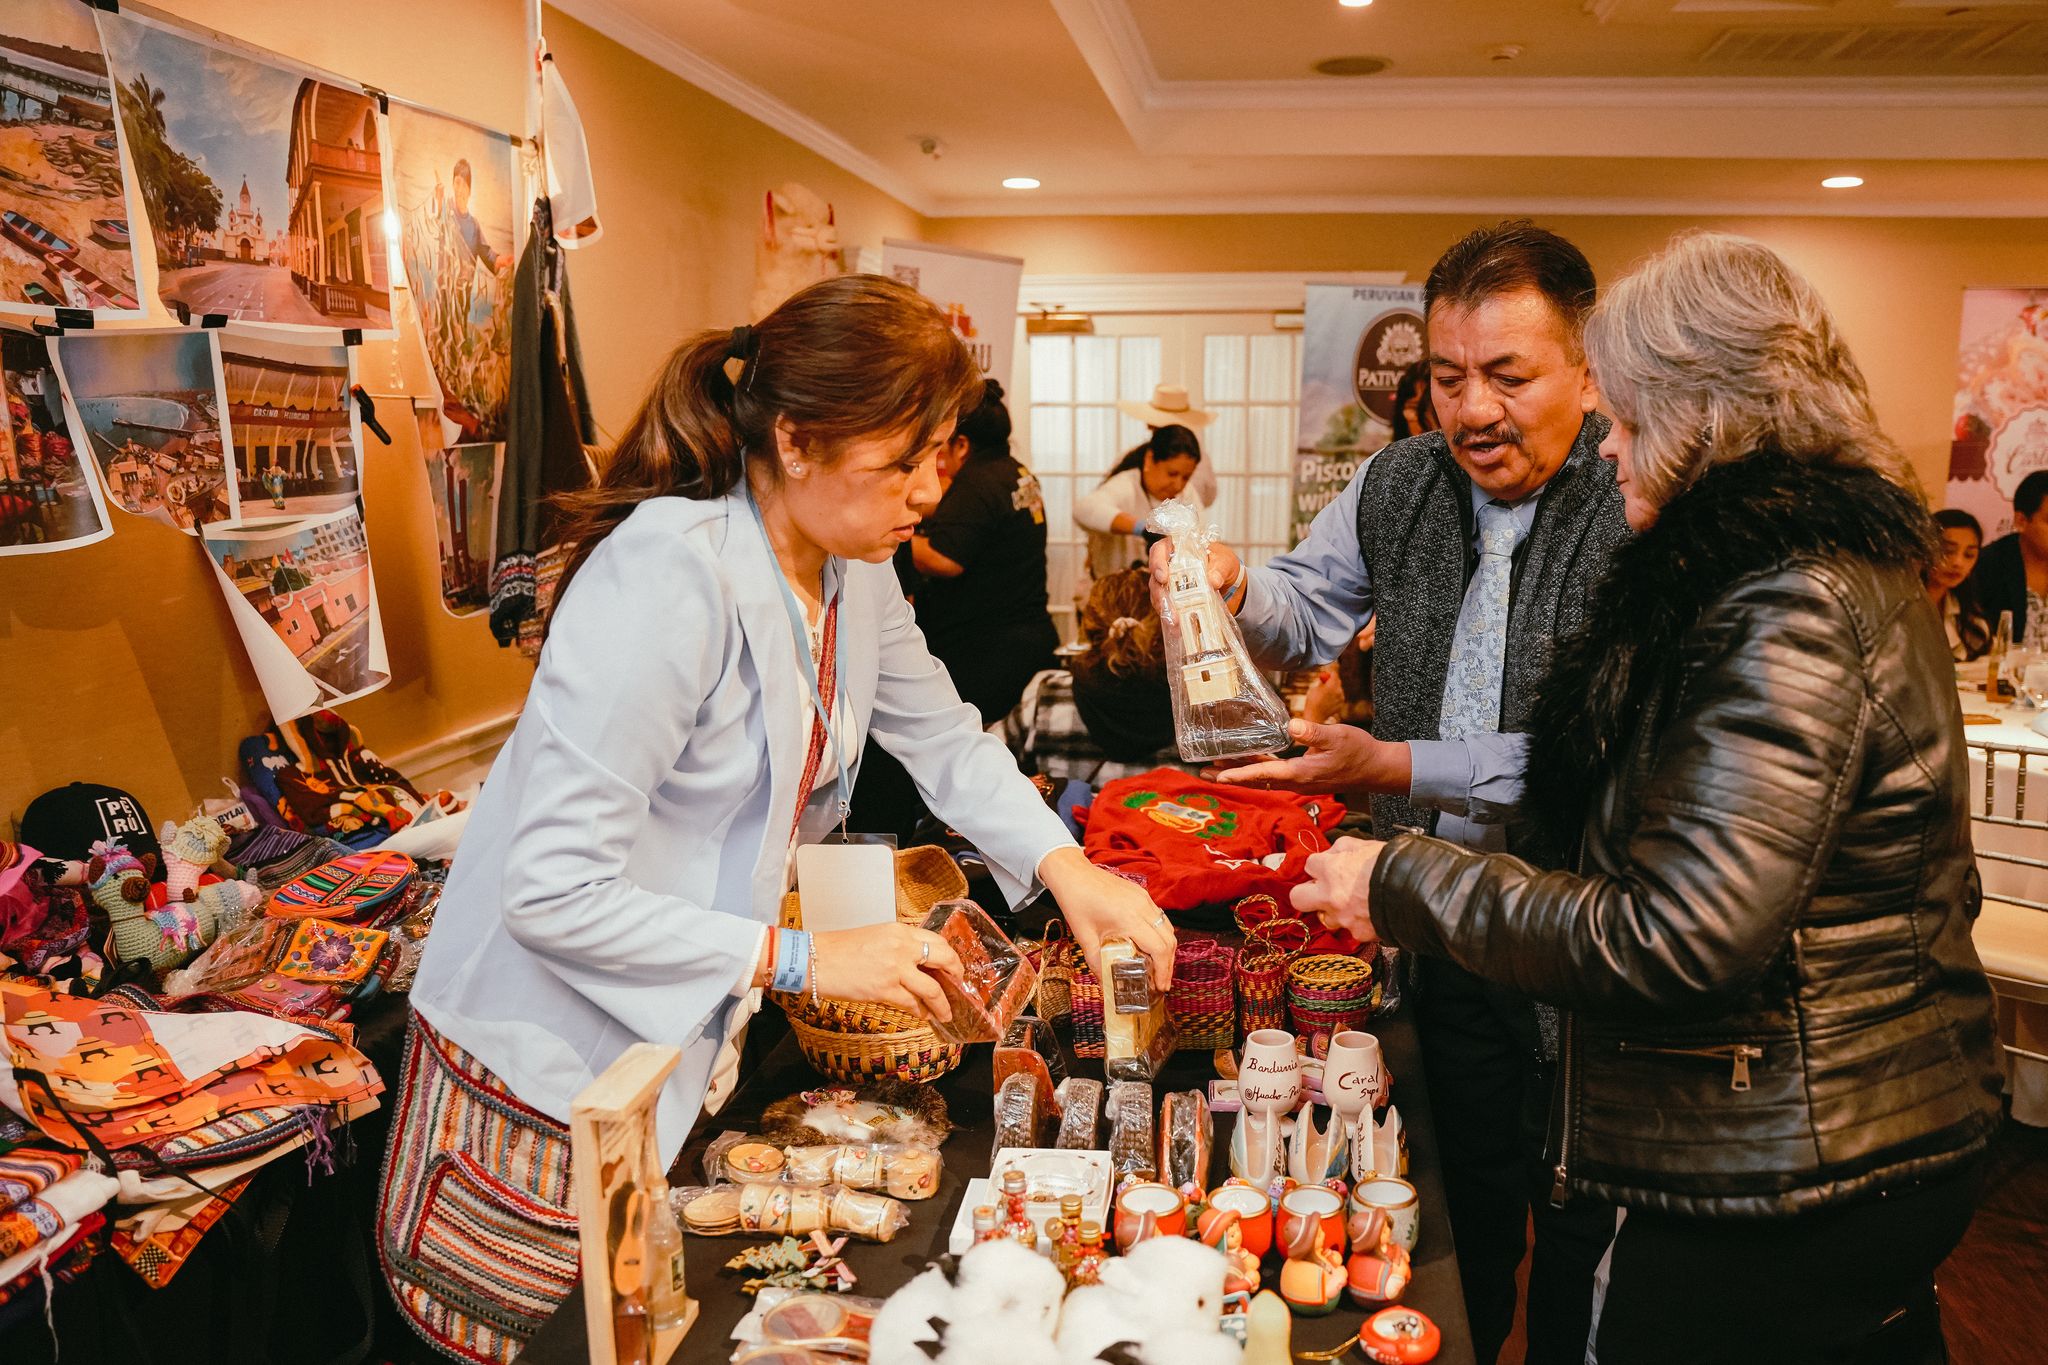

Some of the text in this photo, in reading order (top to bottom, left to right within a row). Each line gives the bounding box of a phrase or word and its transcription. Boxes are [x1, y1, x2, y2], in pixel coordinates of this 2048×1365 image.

[1352, 289, 1415, 302] PERUVIAN
[1358, 368, 1405, 387] PATIV
[253, 408, 278, 418] CASINO
[1300, 457, 1355, 483] Pisco
[1338, 1063, 1379, 1090] Caral
